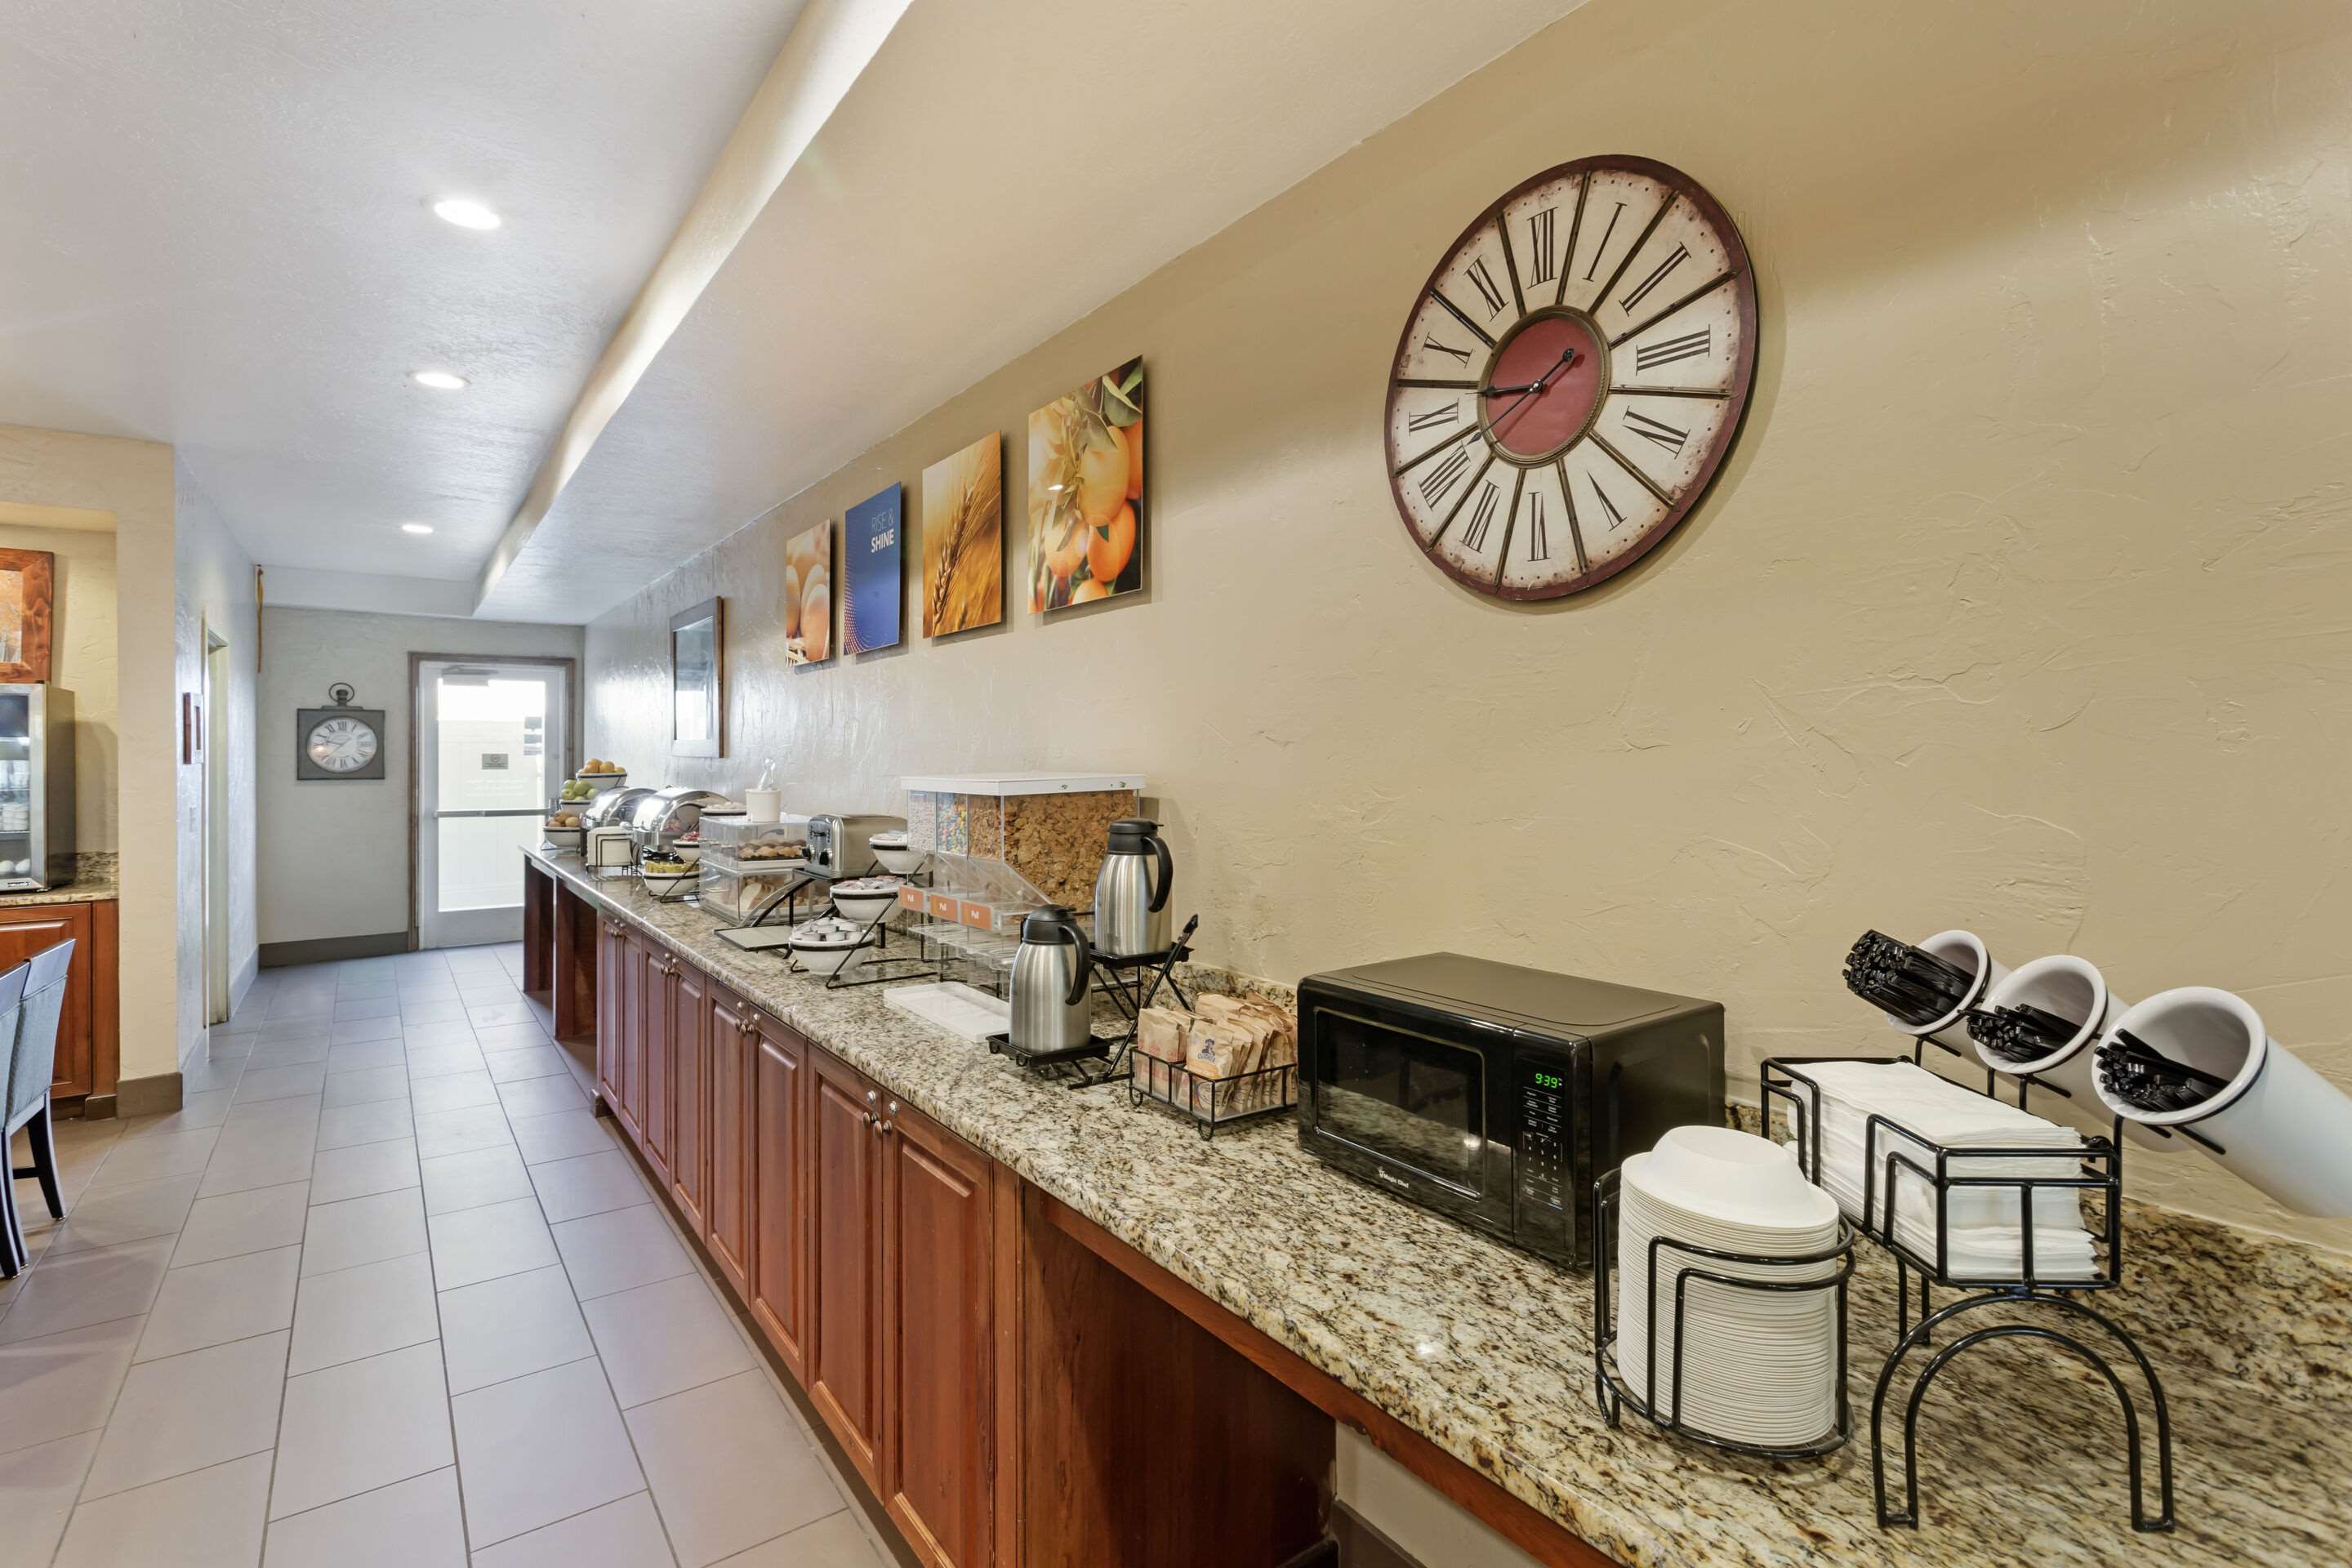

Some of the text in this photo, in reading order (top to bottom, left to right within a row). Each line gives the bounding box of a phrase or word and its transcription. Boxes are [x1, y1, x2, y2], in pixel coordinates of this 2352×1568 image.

[1527, 207, 1558, 289] XII
[1583, 202, 1628, 283] I
[1464, 255, 1510, 322] XI
[1619, 242, 1691, 317] II
[1423, 332, 1473, 368] X
[1636, 324, 1712, 376] III
[1409, 399, 1459, 436] IX
[1622, 405, 1691, 460] IV
[871, 508, 894, 532] RISE &
[1459, 479, 1500, 554] VII
[1527, 492, 1551, 562] VI
[1587, 470, 1628, 531] V
[871, 528, 894, 554] SHINE
